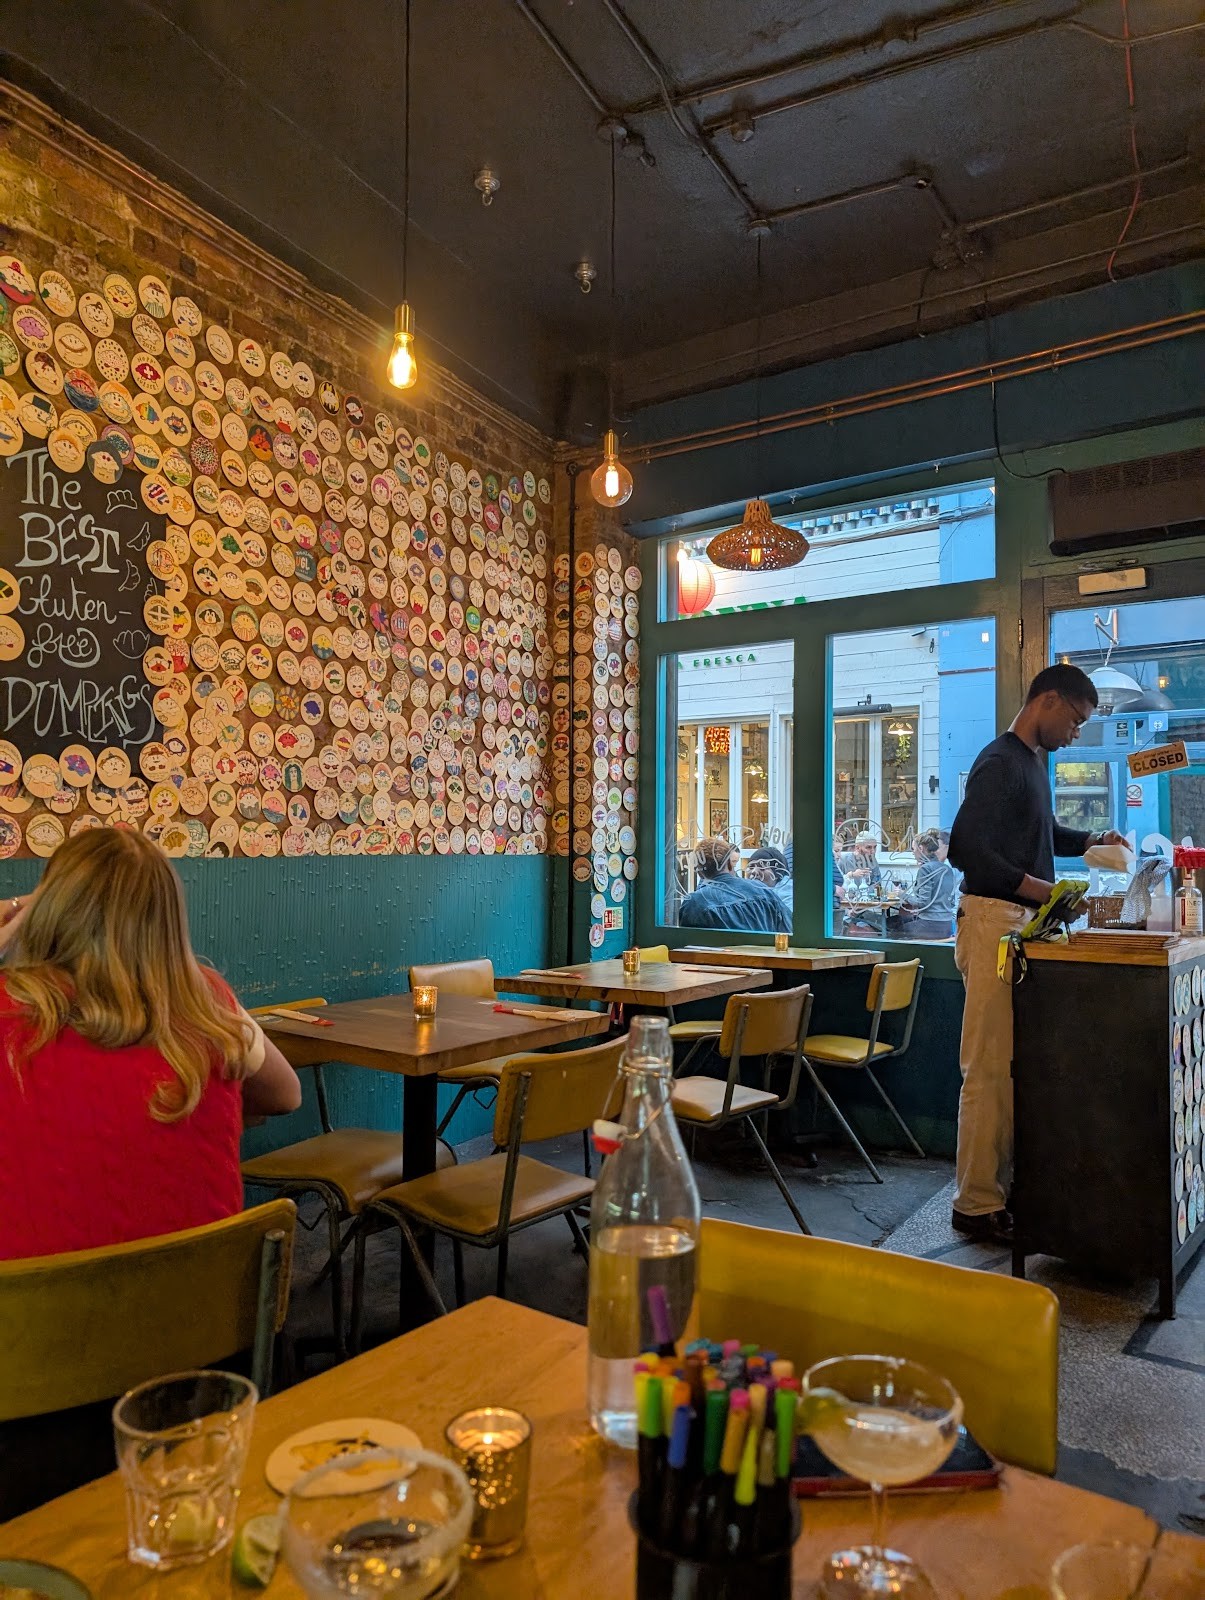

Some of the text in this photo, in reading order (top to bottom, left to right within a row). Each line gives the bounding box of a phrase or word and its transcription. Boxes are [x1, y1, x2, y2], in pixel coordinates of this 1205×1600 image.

[5, 446, 82, 512] The
[14, 511, 121, 576] BEST
[16, 574, 132, 626] Gluten-
[26, 622, 102, 669] free
[693, 652, 757, 669] FRESCA
[1, 674, 156, 750] DUMPLINGS
[1133, 751, 1184, 773] CLOSED
